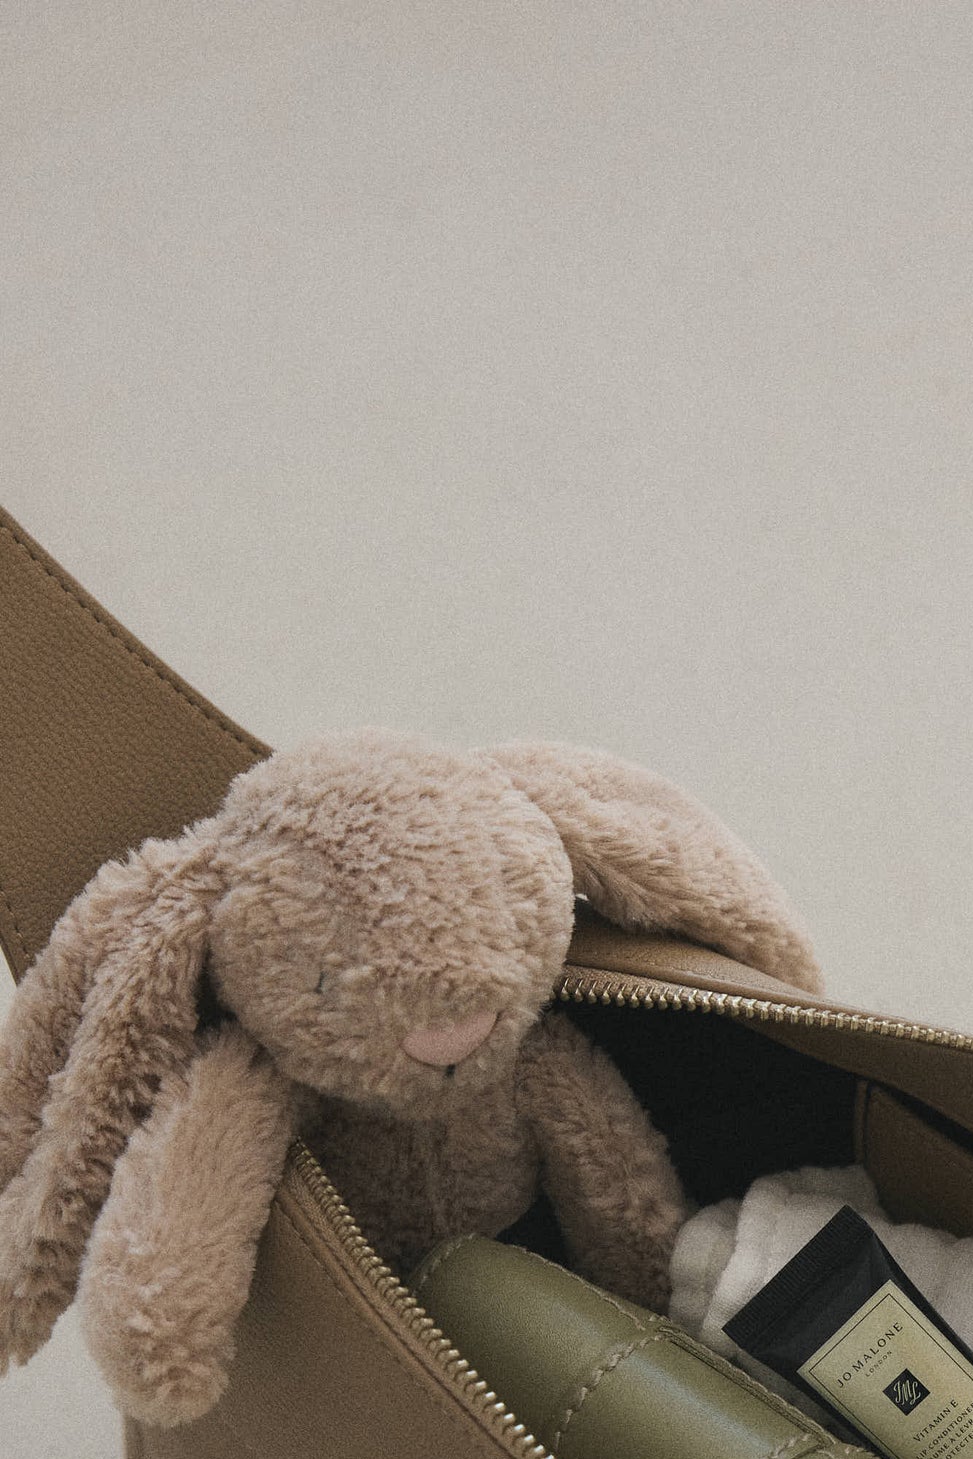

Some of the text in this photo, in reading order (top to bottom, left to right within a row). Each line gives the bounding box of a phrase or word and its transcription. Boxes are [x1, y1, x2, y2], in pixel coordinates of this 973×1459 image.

[837, 1322, 903, 1388] JO MALONE
[865, 1350, 892, 1377] LONDON
[913, 1399, 959, 1442] VITAMIN E
